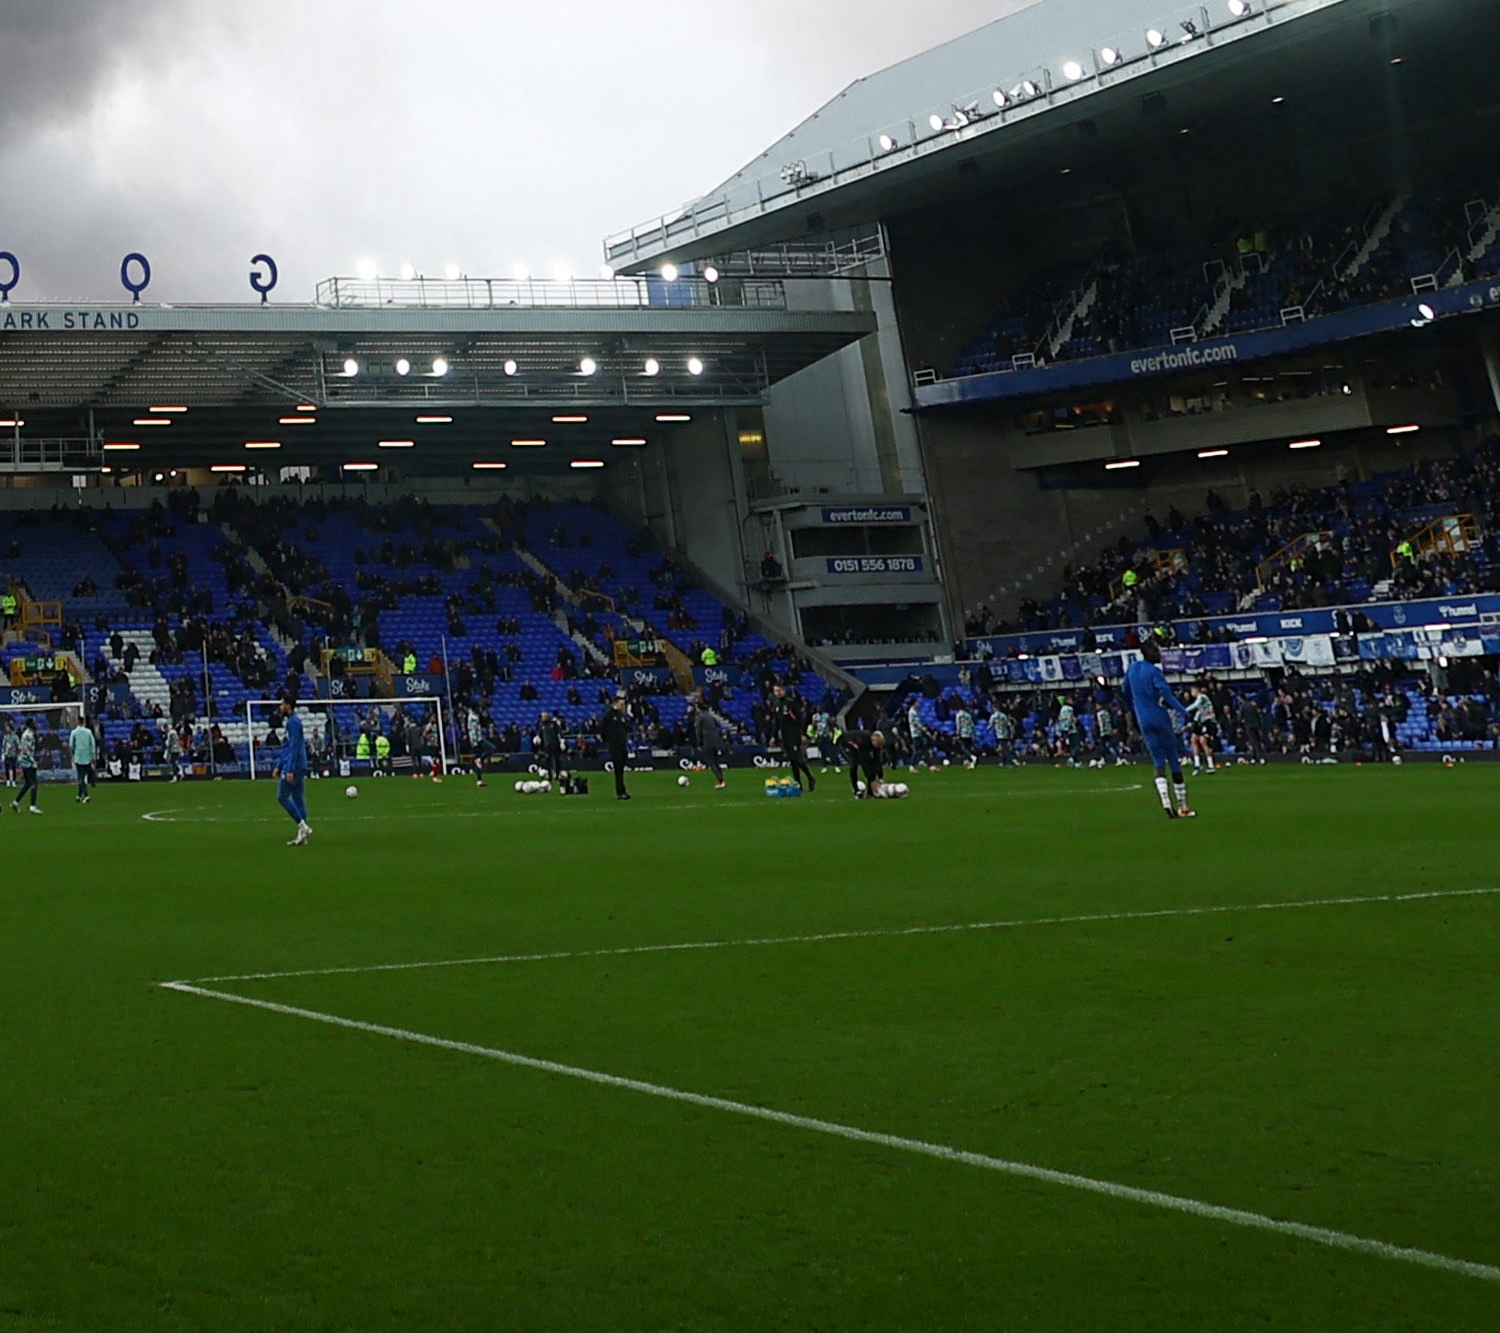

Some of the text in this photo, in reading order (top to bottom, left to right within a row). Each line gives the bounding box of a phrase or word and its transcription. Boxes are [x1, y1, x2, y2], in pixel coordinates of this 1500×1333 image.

[63, 312, 140, 330] STAND
[1130, 343, 1238, 374] evertonfc.com
[829, 508, 904, 522] evertonfc.com
[833, 558, 916, 572] 0151 556 1878
